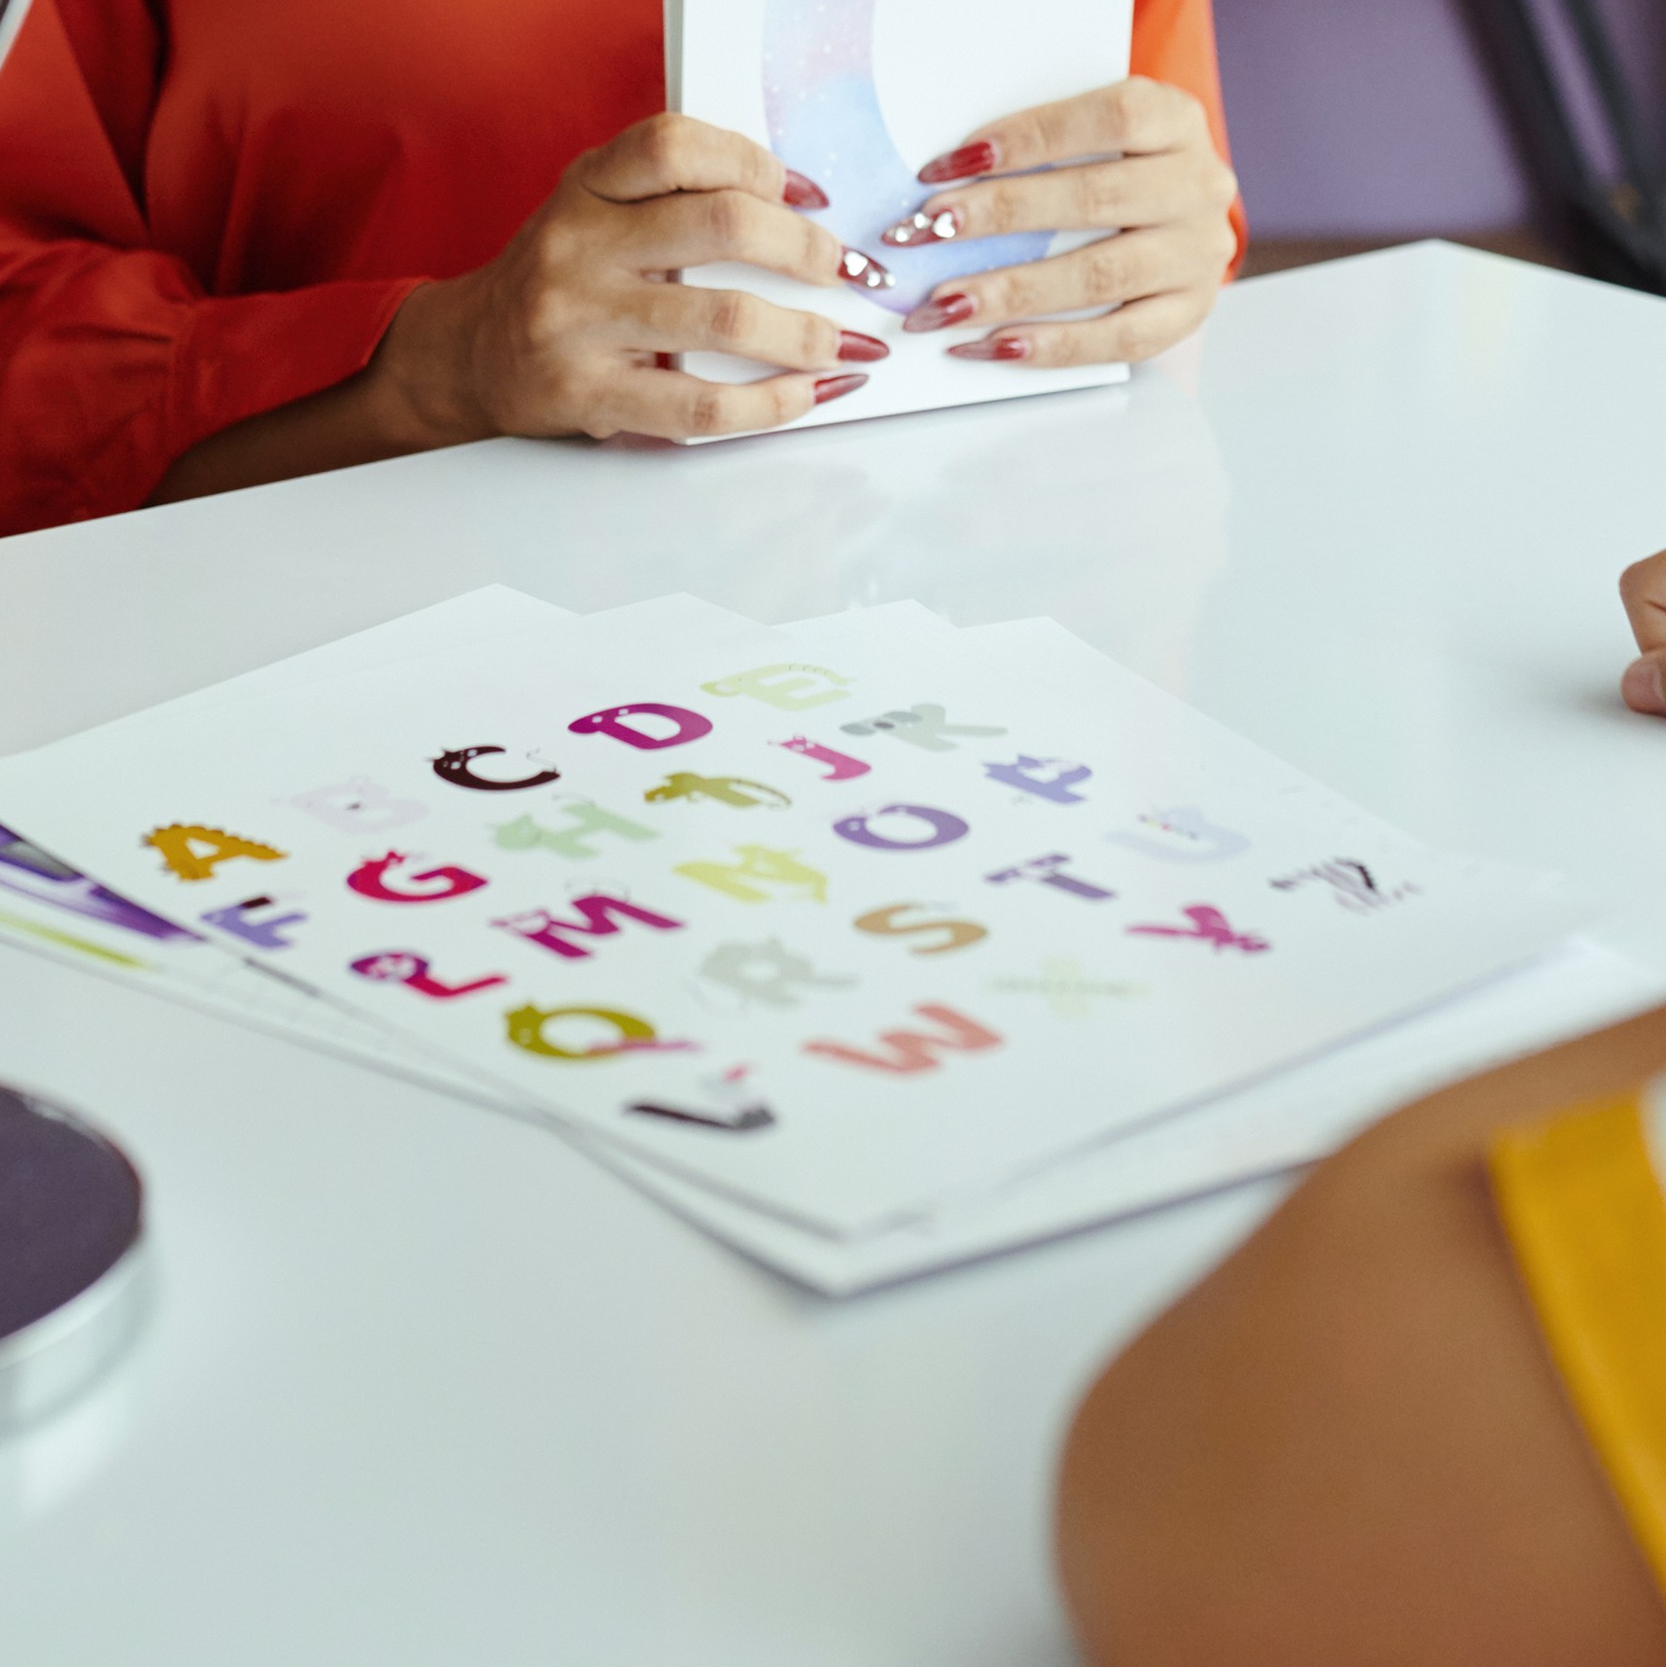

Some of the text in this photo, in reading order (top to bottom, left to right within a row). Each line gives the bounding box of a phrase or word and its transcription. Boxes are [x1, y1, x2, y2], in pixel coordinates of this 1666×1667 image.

[141, 821, 289, 883] A
[275, 774, 431, 835] B
[426, 744, 562, 792] C
[567, 702, 714, 752] D
[700, 662, 856, 712] E
[201, 894, 310, 951] F
[345, 849, 490, 905] G
[488, 796, 663, 859] H
[488, 892, 689, 959] M
[831, 802, 971, 852] O
[853, 901, 989, 955] S
[984, 853, 1118, 902] T
[800, 1002, 1006, 1078] W
